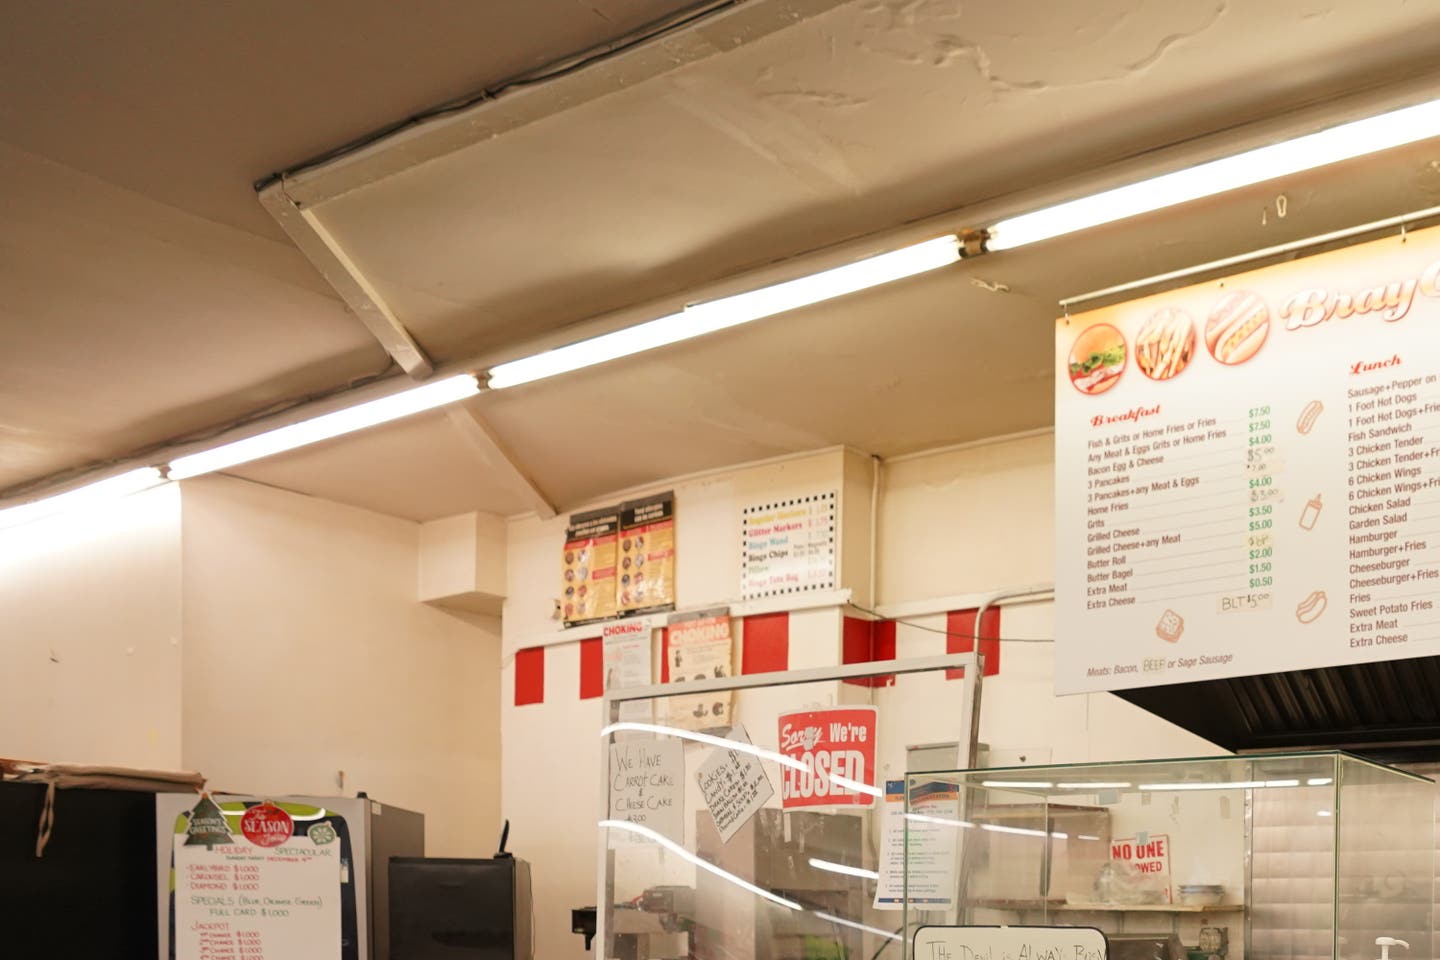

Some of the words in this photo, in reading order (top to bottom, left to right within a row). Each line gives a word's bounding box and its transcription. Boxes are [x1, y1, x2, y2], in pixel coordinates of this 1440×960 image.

[1280, 279, 1419, 331] Bray
[1350, 354, 1402, 375] Lunch
[1090, 404, 1161, 428] Breakfast
[1087, 439, 1103, 448] Fish
[1104, 437, 1110, 446] &
[1112, 434, 1130, 444] Grits
[1132, 432, 1140, 440] or
[1142, 428, 1164, 438] Home
[1165, 424, 1185, 434] Fries
[1186, 422, 1194, 430] or
[1197, 418, 1216, 427] Fries
[1348, 431, 1366, 441] Fish
[1368, 422, 1412, 438] Sandwich
[1348, 462, 1354, 471] 3
[1356, 457, 1391, 469] Chicken
[1087, 480, 1092, 488] 3
[1094, 475, 1130, 487] Pancakes
[1348, 476, 1354, 485] 6
[1356, 472, 1391, 484] Chicken
[1393, 467, 1421, 478] Wings
[1087, 506, 1108, 515] Home
[1110, 502, 1128, 511] Fries
[1348, 503, 1383, 515] Chicken
[1386, 496, 1410, 509] Salad
[1087, 519, 1104, 528] Grits
[1348, 518, 1380, 529] Garden
[1382, 512, 1407, 524] Salad
[1086, 531, 1110, 542] Grilled
[1112, 528, 1140, 538] Cheese
[1348, 530, 1397, 544] Hamburger
[1086, 559, 1110, 569] Butter
[1111, 555, 1126, 565] Roll
[1349, 558, 1410, 574] Cheeseburger
[1086, 572, 1110, 582] Butter
[1111, 568, 1133, 579] Bagel
[1086, 586, 1106, 596] Extra
[1108, 583, 1127, 592] Meat
[1086, 600, 1106, 609] Extra
[1108, 596, 1135, 606] Cheese
[1349, 593, 1370, 603] Fries
[1349, 606, 1376, 618] Sweet
[1379, 603, 1408, 614] Potato
[1410, 600, 1432, 610] Fries
[604, 622, 643, 637] CHOKING
[830, 723, 867, 743] We're
[782, 750, 864, 801] CLOSED
[244, 820, 289, 834] SEASON
[1112, 844, 1132, 860] NO
